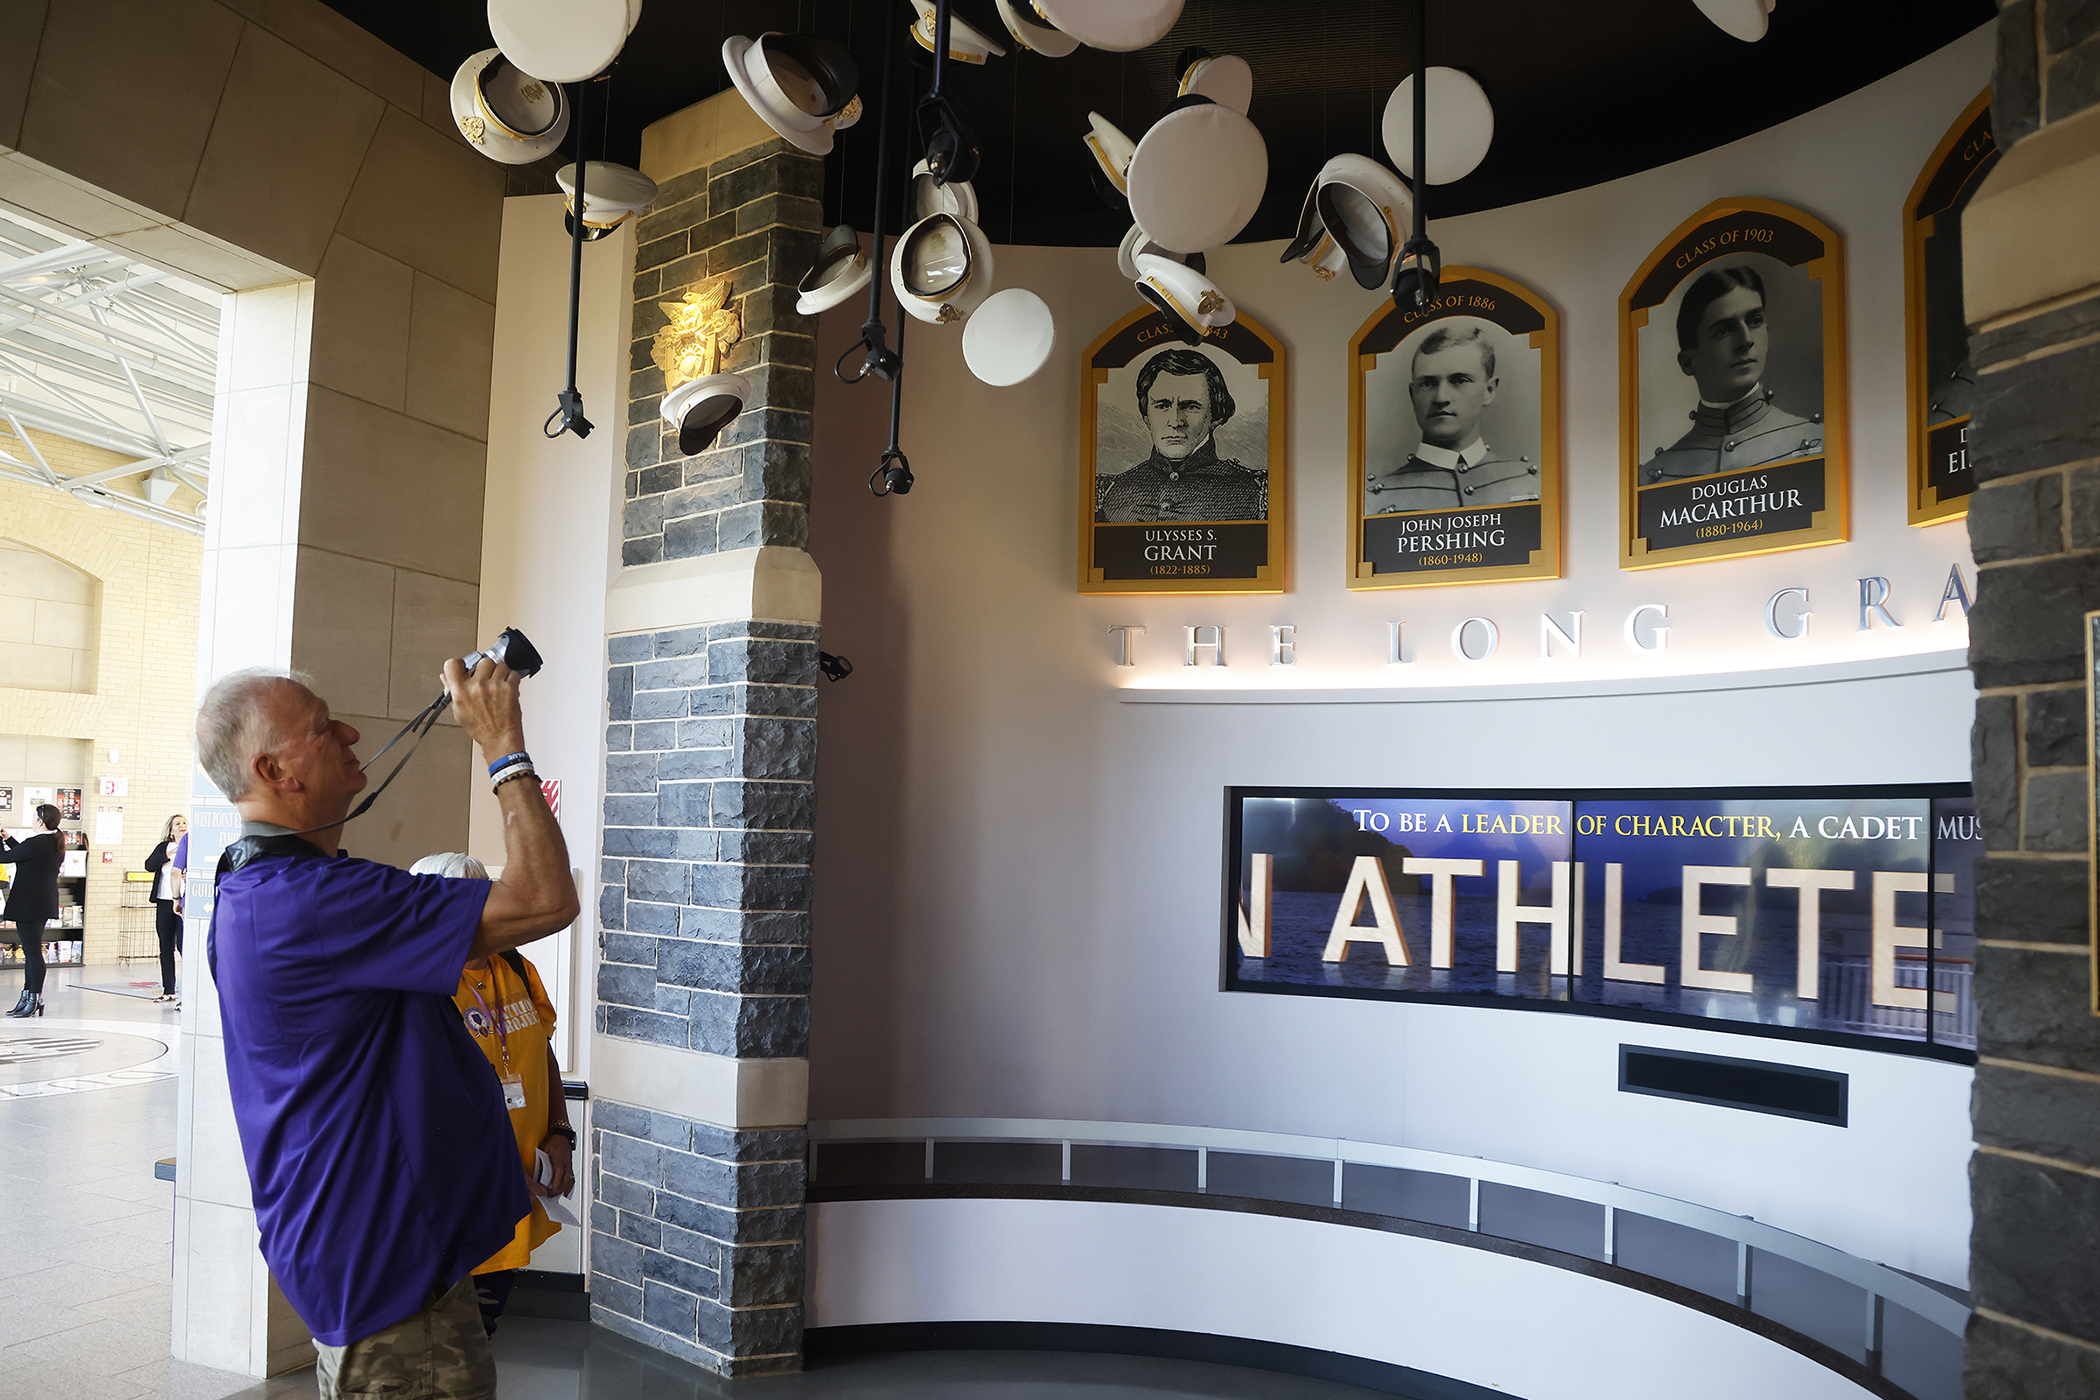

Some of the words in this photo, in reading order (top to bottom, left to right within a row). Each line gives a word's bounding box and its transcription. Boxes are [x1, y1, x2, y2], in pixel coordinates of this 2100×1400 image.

[1676, 236, 1716, 269] CLASS
[1720, 229, 1740, 245] OF
[1744, 228, 1774, 243] 1903
[1403, 298, 1443, 323] CLSS
[1446, 295, 1465, 307] OF
[1468, 295, 1496, 311] 1886
[1204, 324, 1229, 340] 843
[1691, 474, 1769, 501] DOUGLAS
[1660, 488, 1803, 529] MACARTHUR
[1145, 529, 1203, 542] ULYSSES
[1206, 529, 1217, 541] S.
[1400, 517, 1443, 536] JOHN
[1446, 512, 1502, 533] JOSEPH
[1695, 518, 1764, 539] (1880-1964)
[1144, 544, 1218, 561] GRANT
[1397, 529, 1506, 554] PERSHING
[1150, 564, 1211, 575] (1822-1885)
[1418, 552, 1483, 566] (1860-1948)
[1107, 623, 1298, 667] THE
[1385, 602, 1672, 665] LONG
[1764, 562, 1973, 640] GRA
[105, 780, 124, 795] EXI
[194, 811, 212, 828] WEST
[212, 811, 234, 829] POINT
[1399, 812, 1428, 833] BE
[1433, 813, 1454, 833] A
[1461, 813, 1566, 835] LEADER
[1576, 815, 1607, 836] OF
[1614, 814, 1782, 842] CHARACTER,
[1788, 816, 1811, 839] A
[1818, 815, 1923, 840] CADET
[1937, 815, 1983, 840] MUS
[1321, 854, 1956, 1014] ATHLETE
